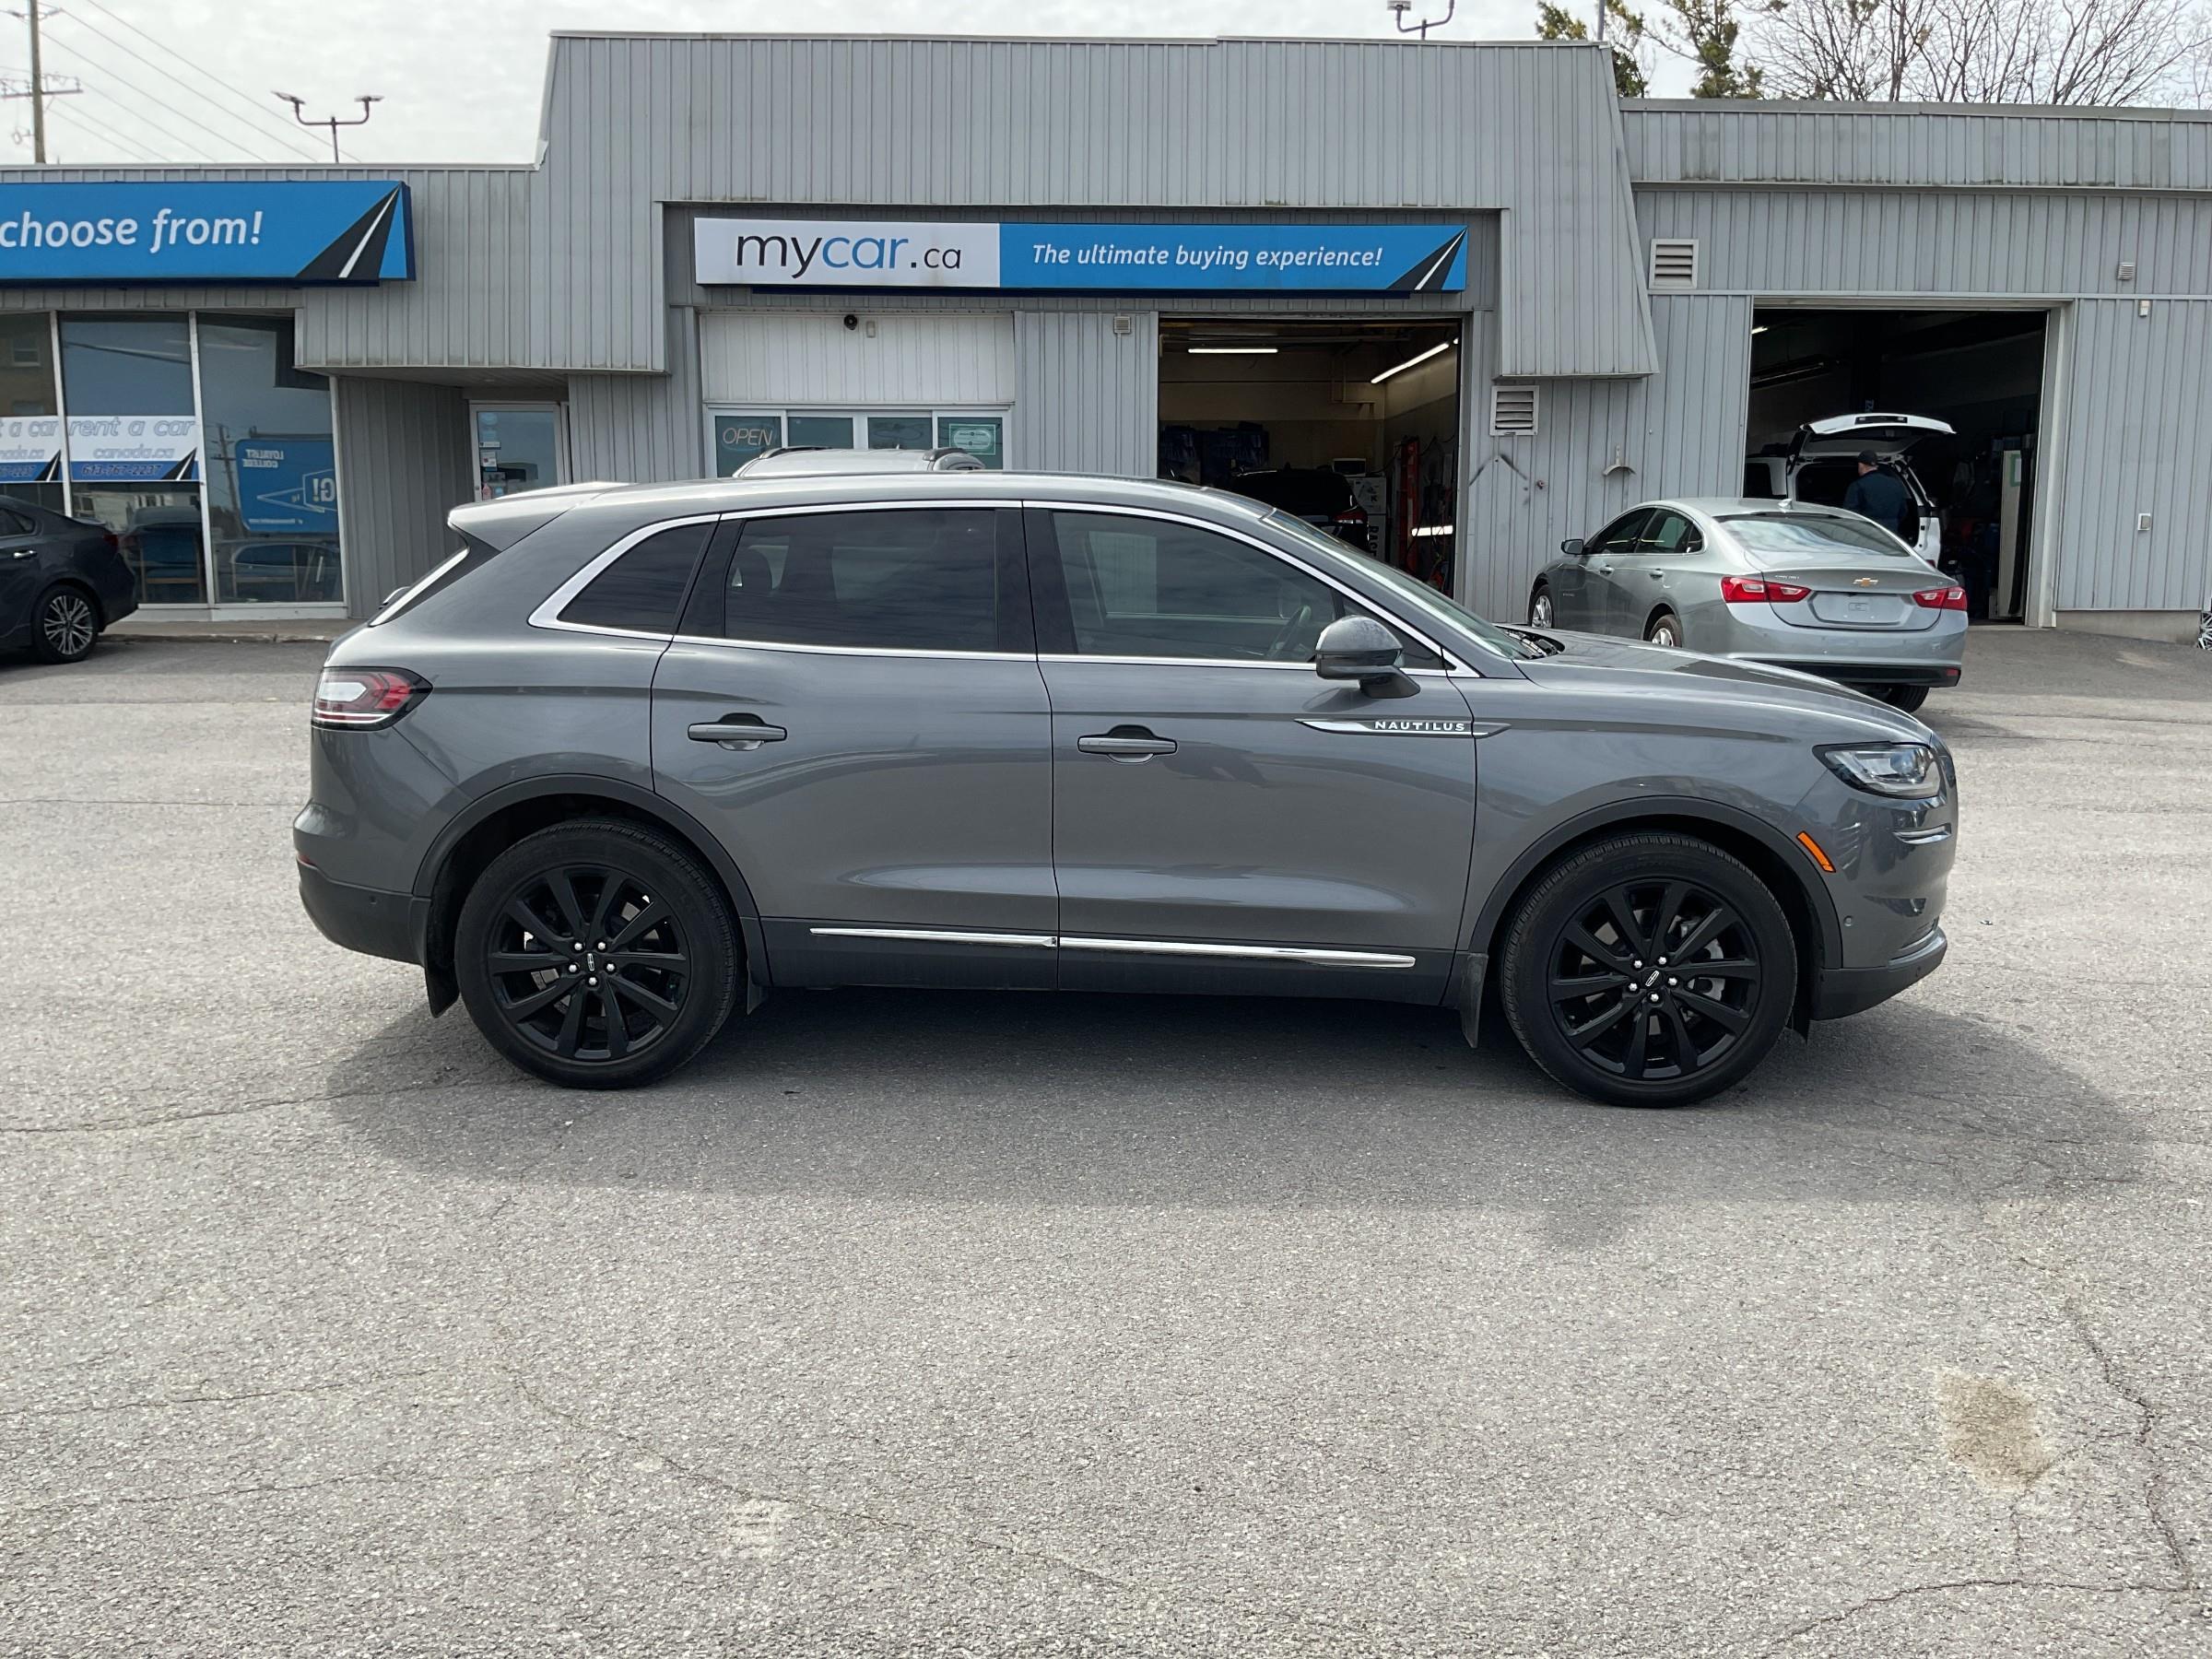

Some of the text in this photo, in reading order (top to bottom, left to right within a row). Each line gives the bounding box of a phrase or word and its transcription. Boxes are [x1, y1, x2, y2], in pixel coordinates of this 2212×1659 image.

[0, 207, 264, 253] choose from!
[736, 234, 962, 279] mycar.ca
[1032, 243, 1382, 271] The ultimate buying experience!
[69, 417, 196, 437] rent a car
[723, 427, 773, 447] OPEN
[93, 443, 176, 459] canada.ca
[1374, 721, 1465, 732] NAUTILUS
